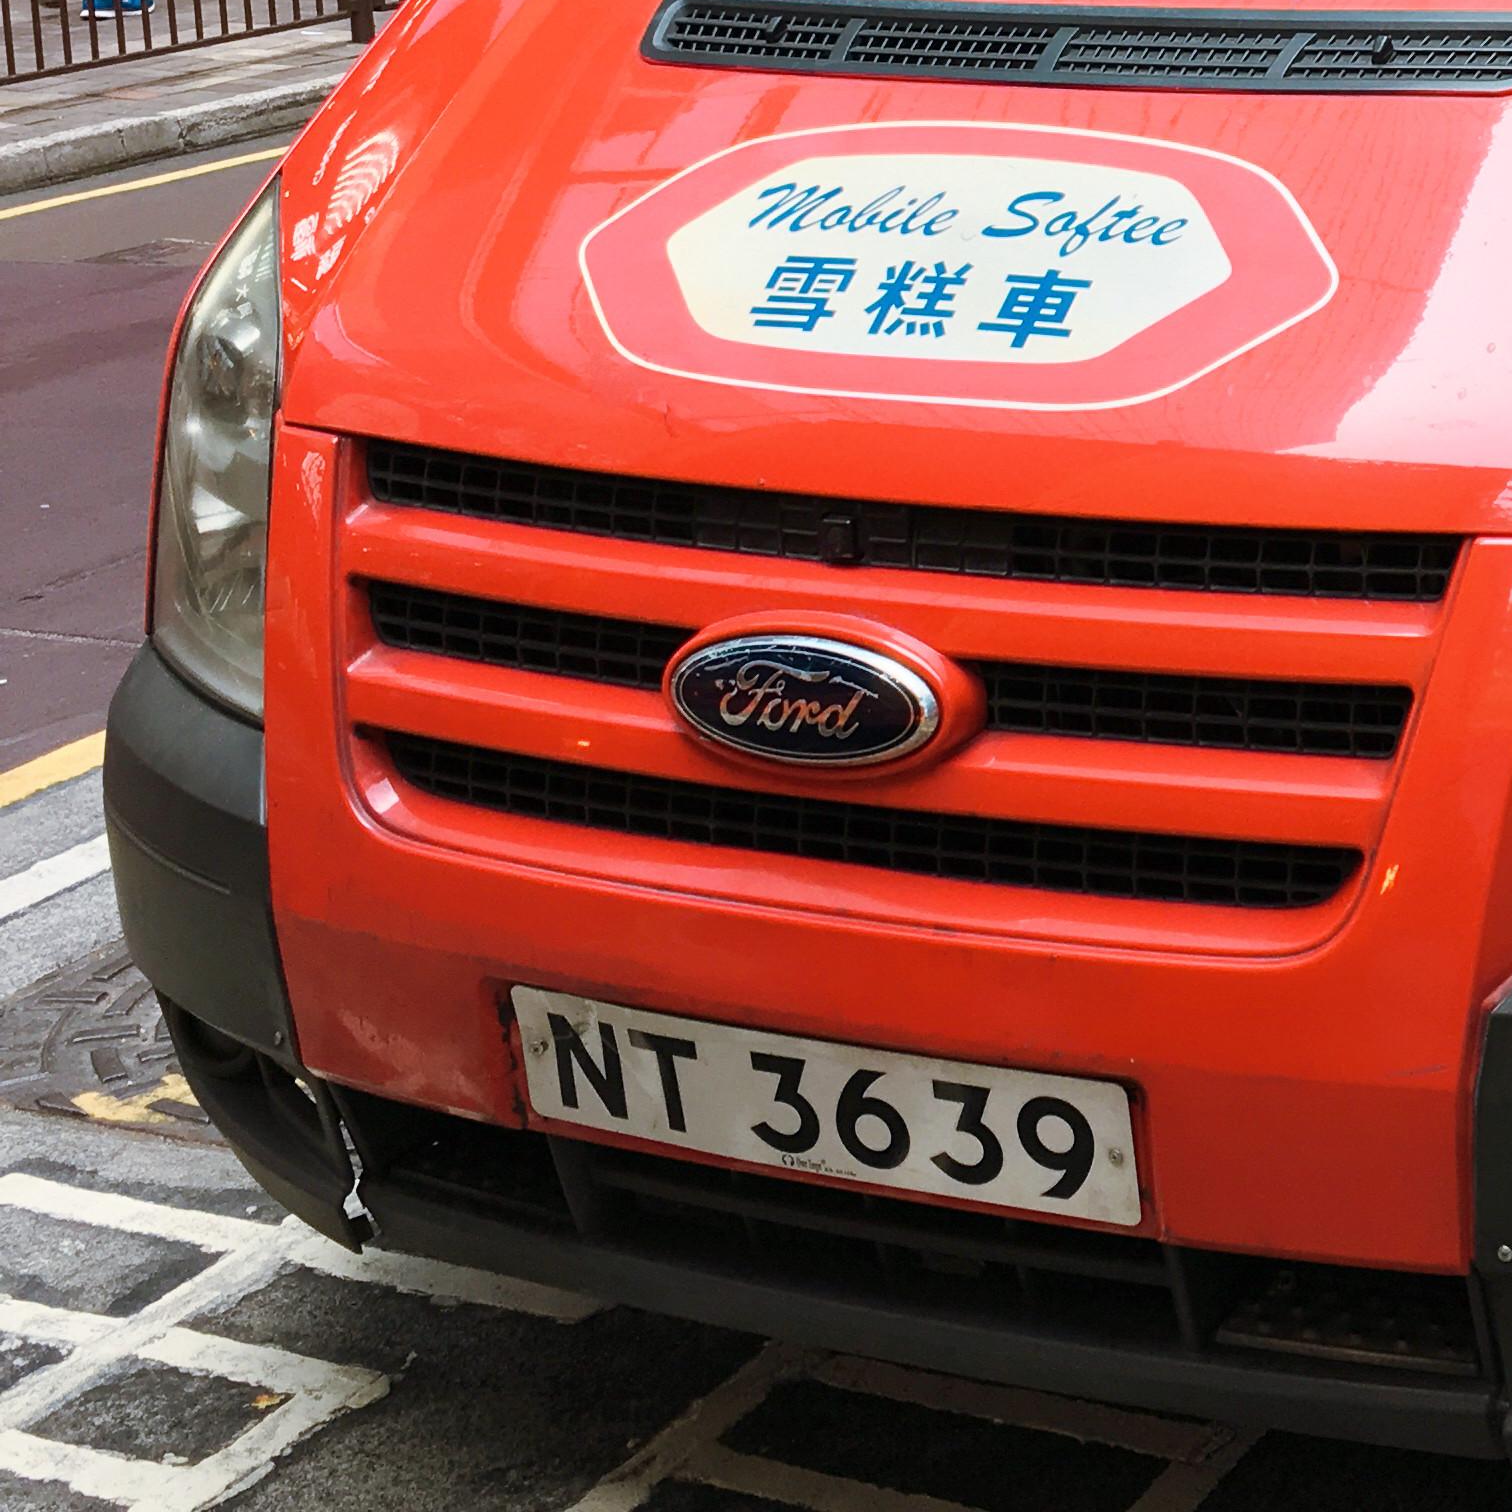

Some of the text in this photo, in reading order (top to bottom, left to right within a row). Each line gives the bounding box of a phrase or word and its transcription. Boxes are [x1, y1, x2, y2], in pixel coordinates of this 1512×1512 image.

[748, 181, 1189, 259] Mobile Softee
[748, 254, 1096, 350] 雪糕車
[718, 658, 860, 740] Ford
[545, 1011, 1096, 1201] NT 3639
